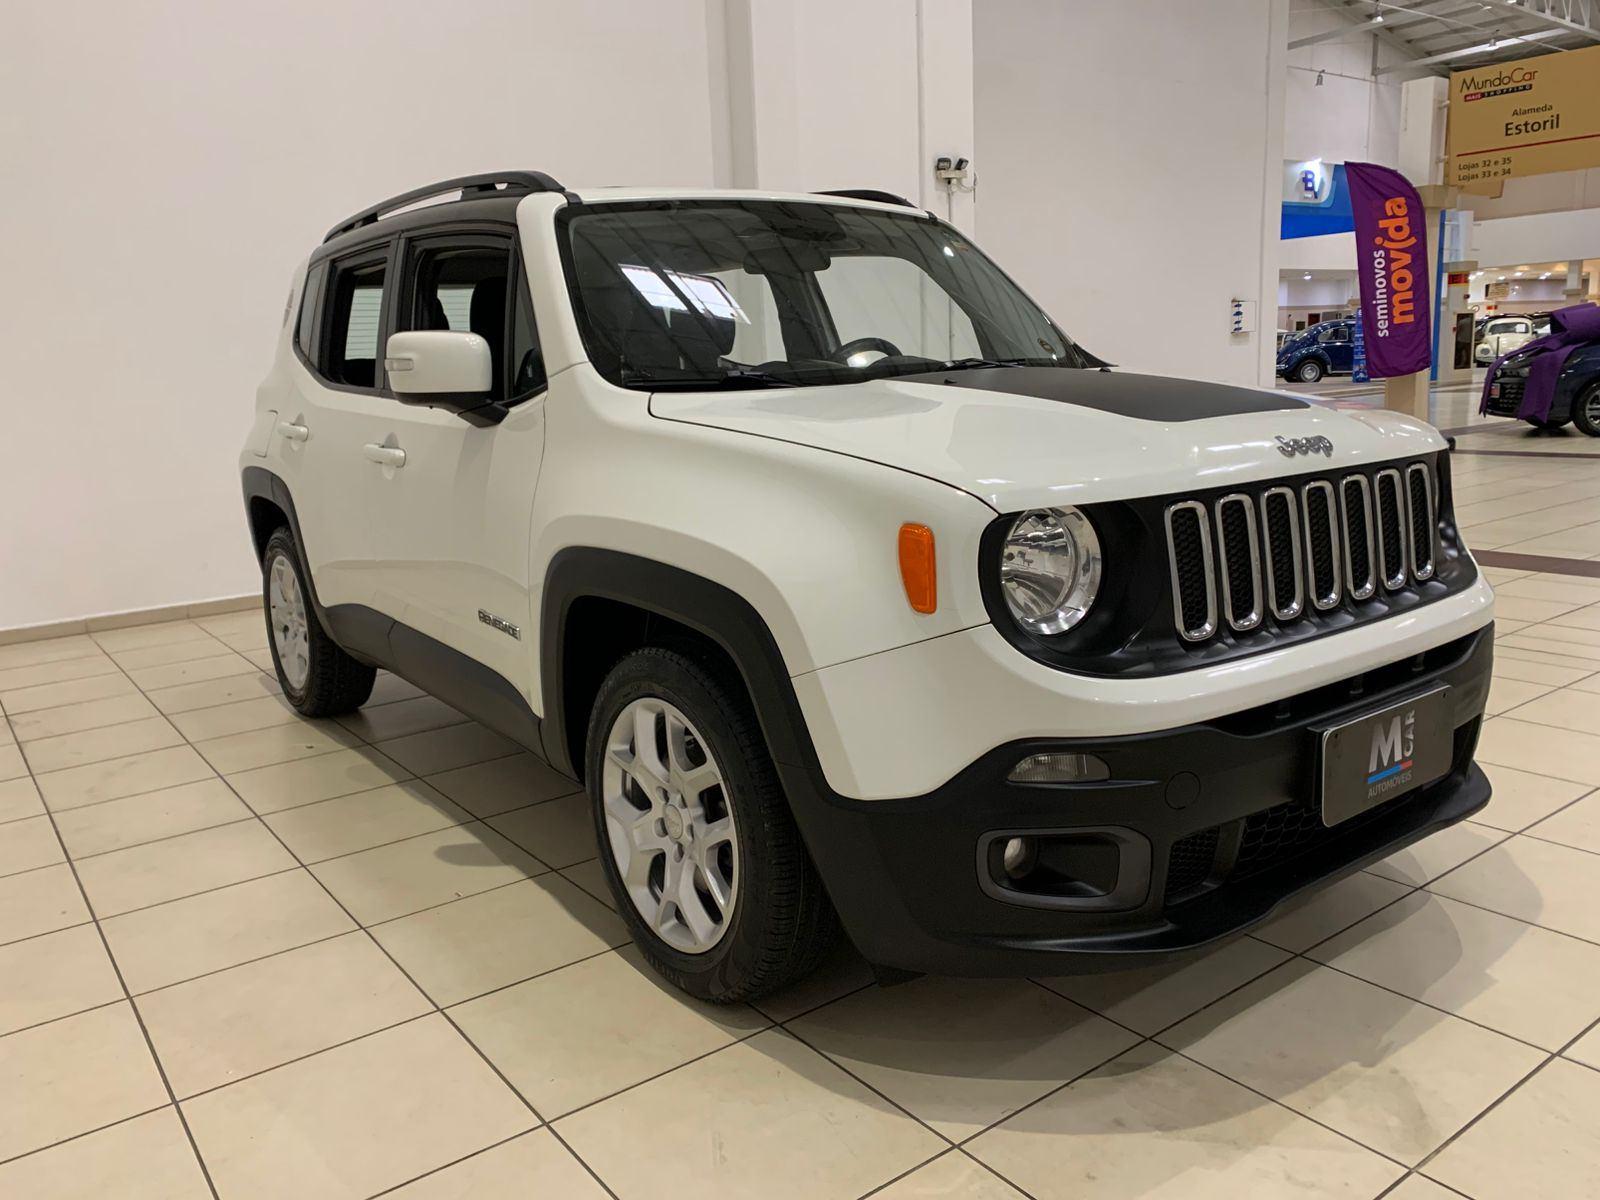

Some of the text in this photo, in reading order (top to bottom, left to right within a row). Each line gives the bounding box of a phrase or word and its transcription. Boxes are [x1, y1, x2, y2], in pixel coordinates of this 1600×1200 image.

[1460, 67, 1538, 93] MundoCar
[1484, 83, 1531, 97] SHOPPING
[1511, 103, 1553, 116] Alameda
[1504, 113, 1560, 137] Estoril
[1458, 162, 1479, 172] Lojas
[1481, 159, 1491, 168] 32
[1501, 156, 1512, 166] 35
[1458, 173, 1479, 182] Lojas
[1481, 170, 1491, 179] 33
[1501, 168, 1512, 176] 34
[1374, 197, 1417, 325] movida
[1373, 249, 1389, 338] seminovos
[1274, 435, 1334, 459] Jeep
[1368, 709, 1415, 774] M CAR
